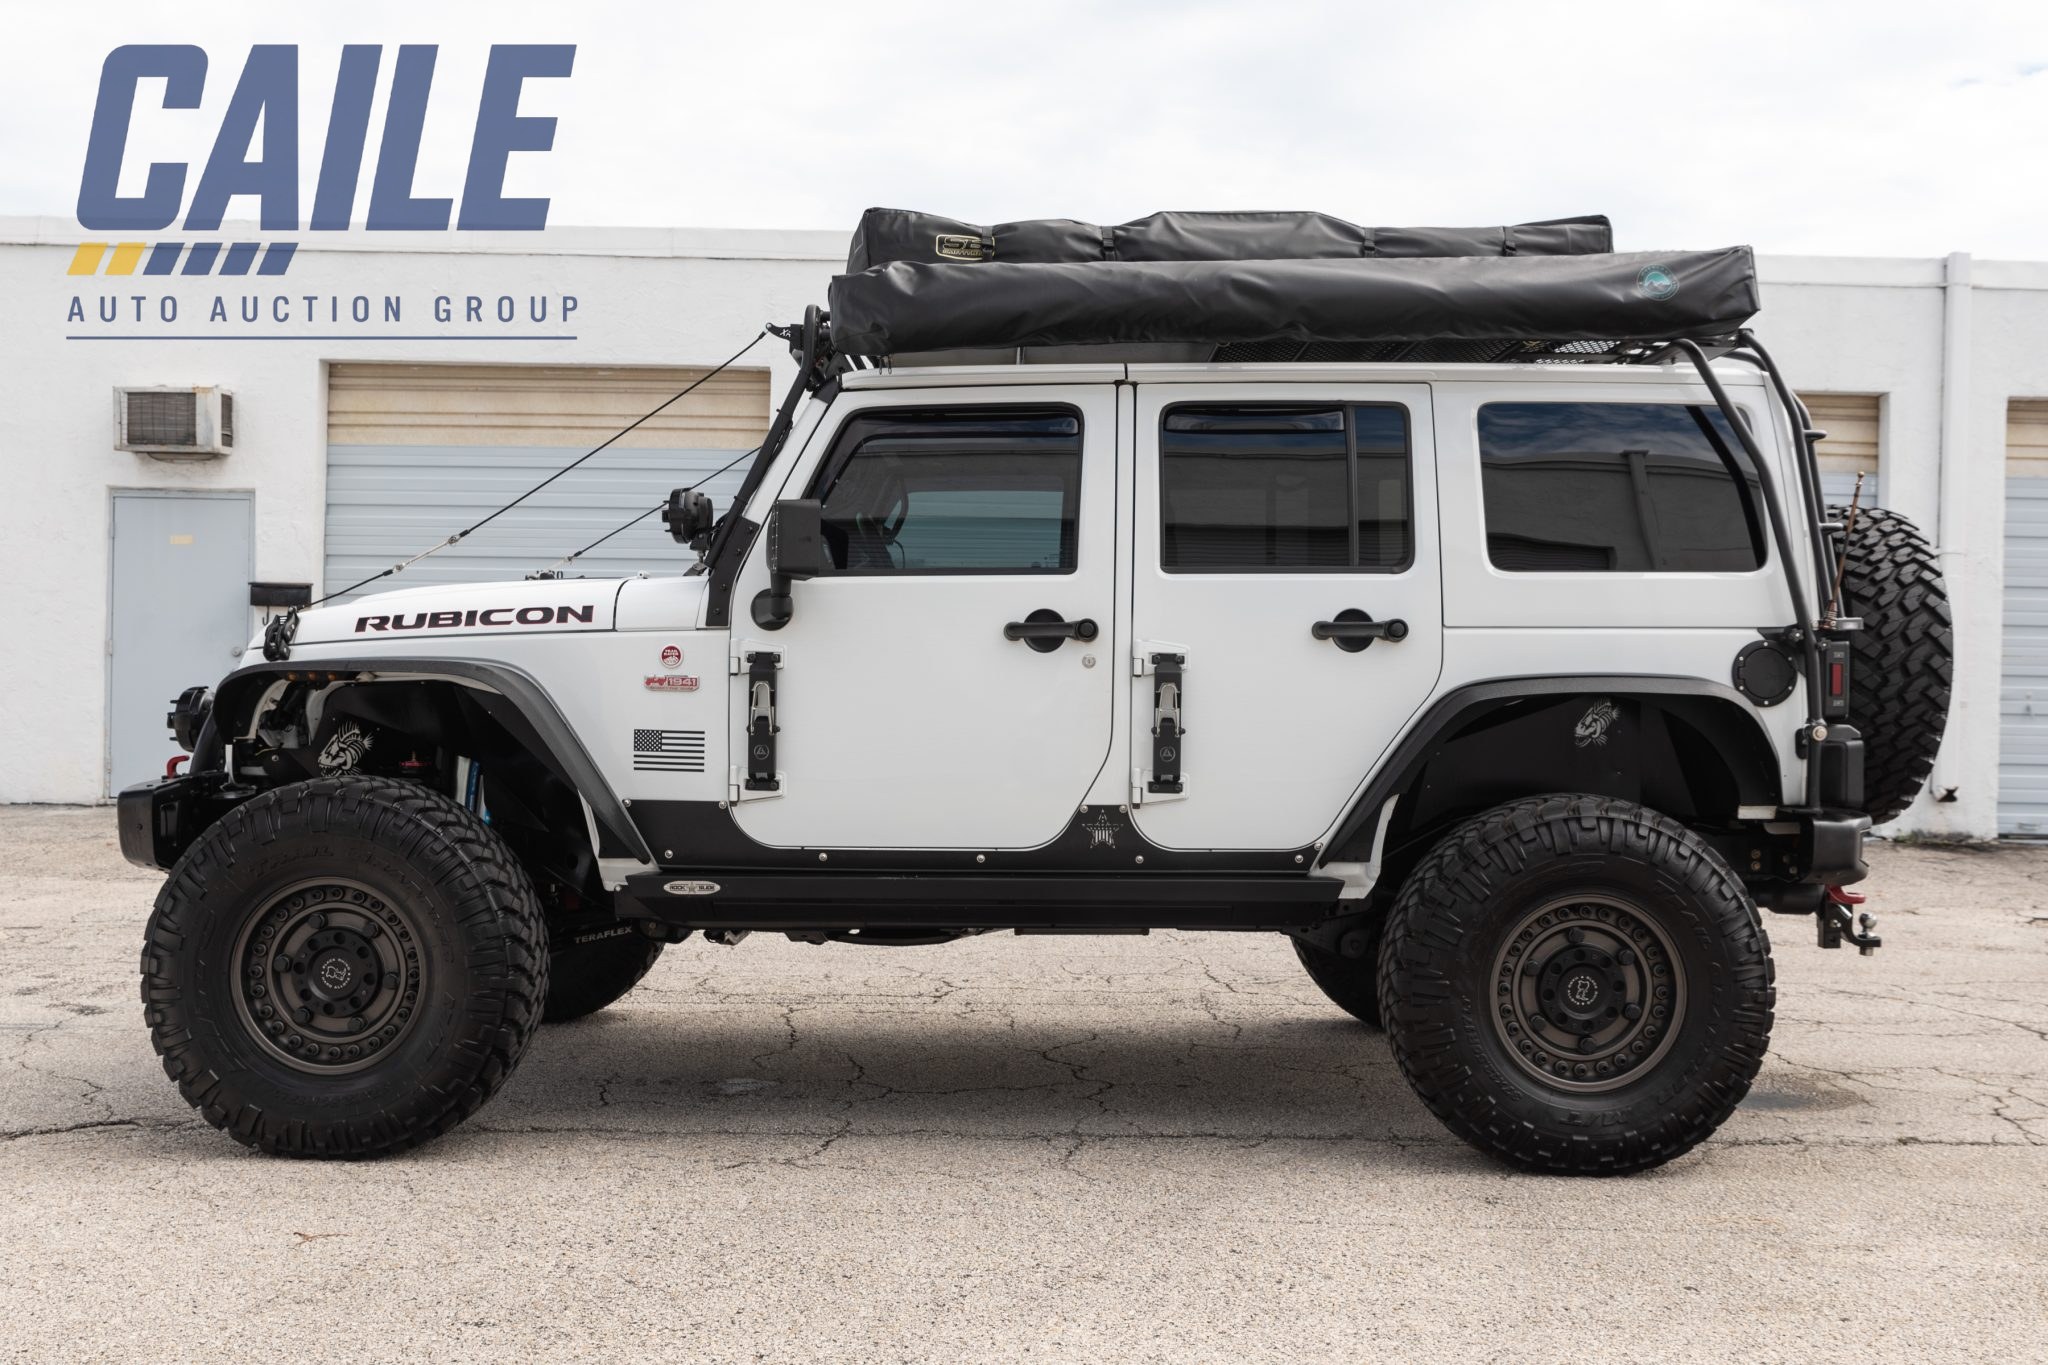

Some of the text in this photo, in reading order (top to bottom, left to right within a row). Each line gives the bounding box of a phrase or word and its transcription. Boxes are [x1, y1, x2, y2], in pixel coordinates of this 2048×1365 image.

[354, 605, 593, 632] RUBICON
[668, 678, 697, 686] 1941
[574, 926, 632, 943] TERAFLEX
